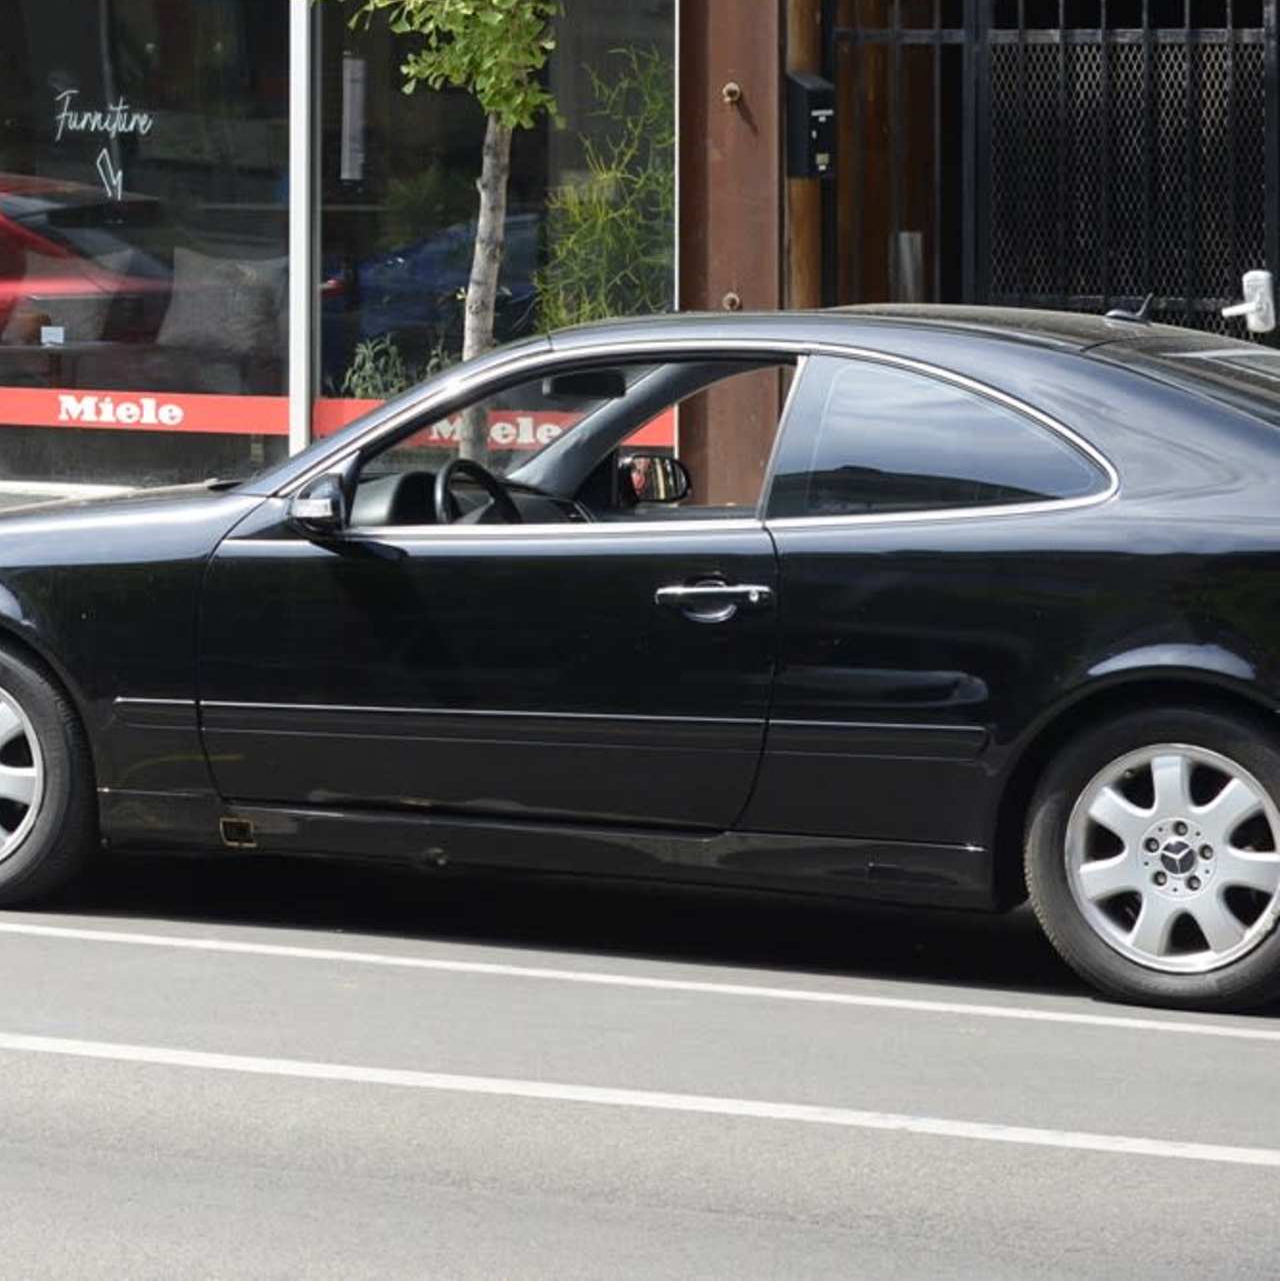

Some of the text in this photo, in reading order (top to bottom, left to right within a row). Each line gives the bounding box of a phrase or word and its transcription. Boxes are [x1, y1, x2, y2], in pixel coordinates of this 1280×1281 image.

[55, 89, 153, 142] Furniture
[58, 394, 184, 426] Miele
[429, 416, 563, 446] Mele
